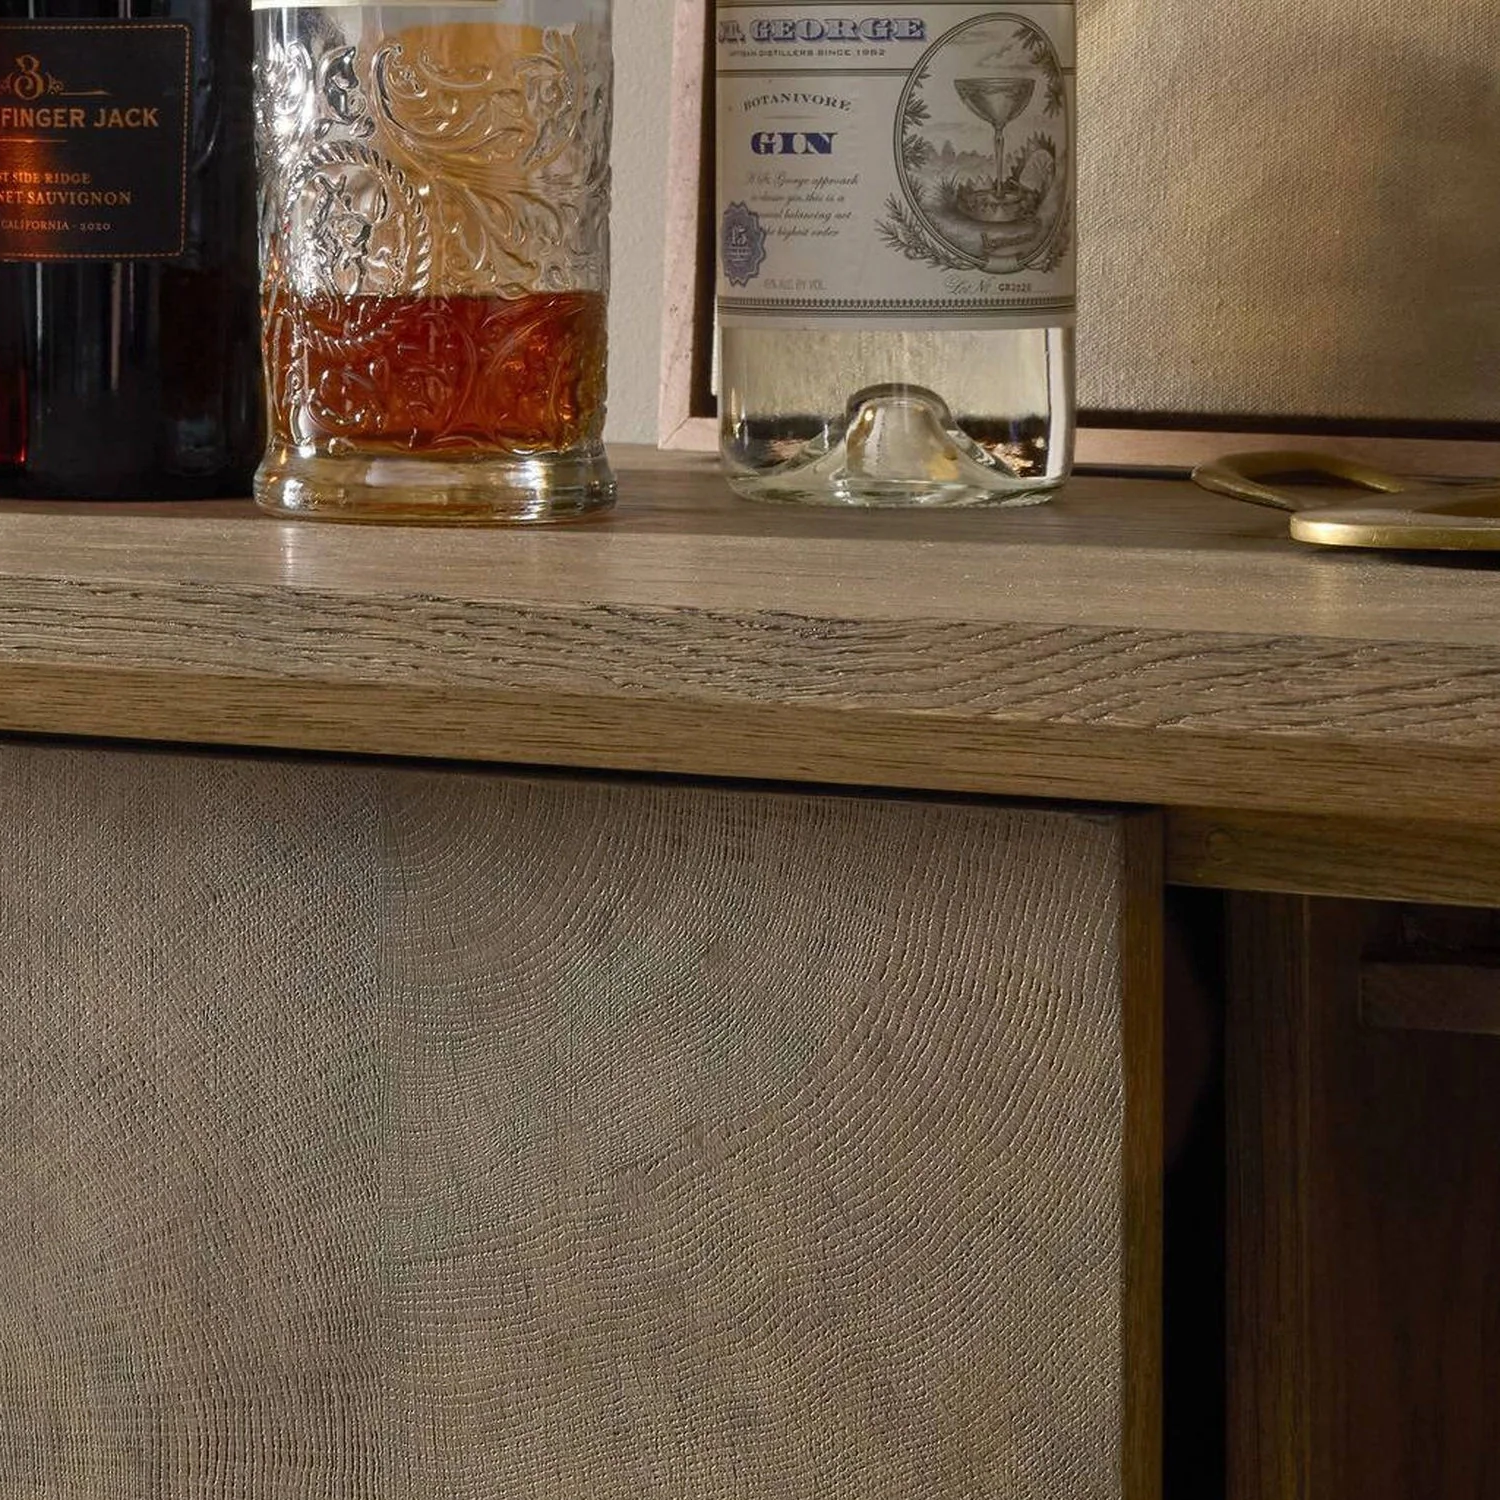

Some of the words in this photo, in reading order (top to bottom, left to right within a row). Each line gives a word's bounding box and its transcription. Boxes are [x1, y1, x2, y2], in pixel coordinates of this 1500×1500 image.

[750, 18, 926, 43] GEORGE
[758, 49, 814, 57] DISTILLERS
[817, 49, 851, 57] SINCE
[742, 92, 852, 112] BOTANIVORE
[1, 107, 85, 128] FINGER
[93, 107, 160, 127] JACK
[750, 131, 838, 155] GIN
[12, 172, 41, 184] SIDE
[44, 172, 92, 185] RIDGE
[27, 190, 132, 206] SAUVIGNON
[1, 218, 70, 230] CALIFORNIA
